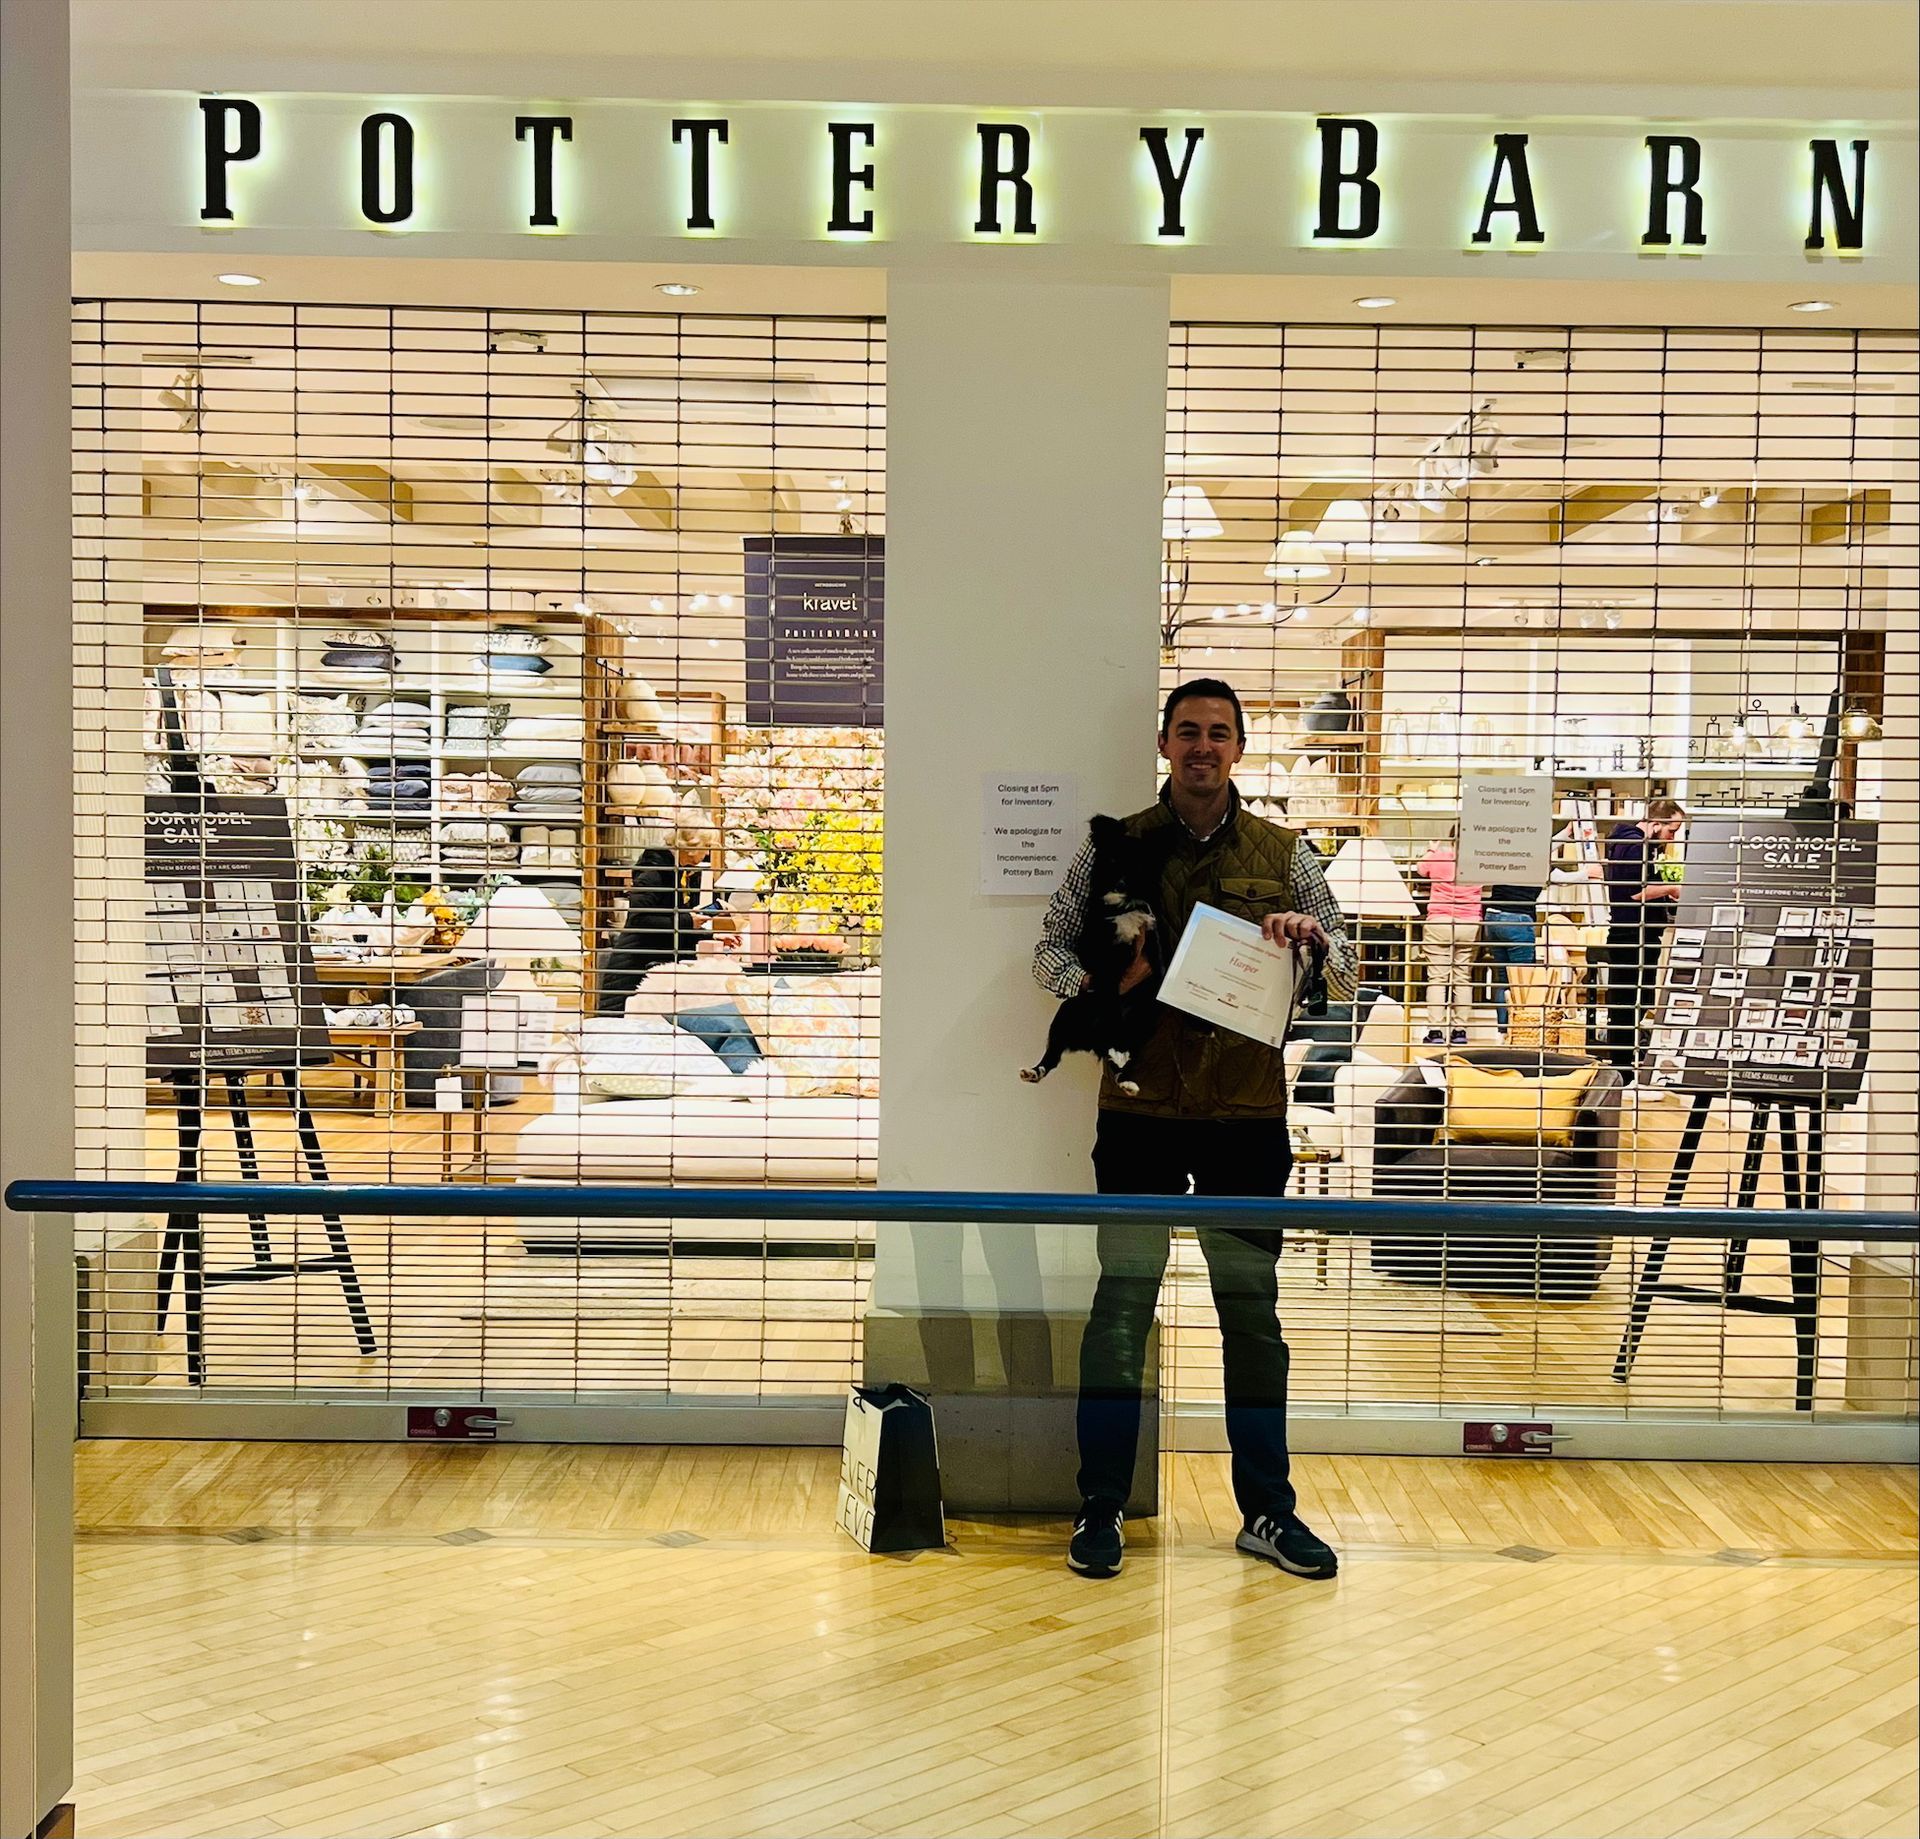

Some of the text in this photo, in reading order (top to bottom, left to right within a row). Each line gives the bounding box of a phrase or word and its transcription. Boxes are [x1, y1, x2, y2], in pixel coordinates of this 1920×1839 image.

[803, 592, 858, 611] kravet
[998, 784, 1059, 794] Closing at 5pm
[1477, 785, 1507, 794] Closing
[1518, 786, 1535, 795] 5pm
[1001, 798, 1012, 806] for
[190, 811, 252, 825] MODEL
[163, 827, 220, 844] SALE
[994, 827, 1062, 836] We apologize for
[1473, 824, 1486, 832] We
[1487, 825, 1525, 834] apologize
[1728, 835, 1862, 852] FLOOR MODEL
[1479, 862, 1527, 871] Pottery Barn
[1763, 852, 1822, 869] SALE
[1003, 868, 1053, 877] Pottery Barn
[1228, 956, 1260, 975] Harper
[840, 1445, 877, 1502] EVER
[844, 1493, 876, 1549] EVE
